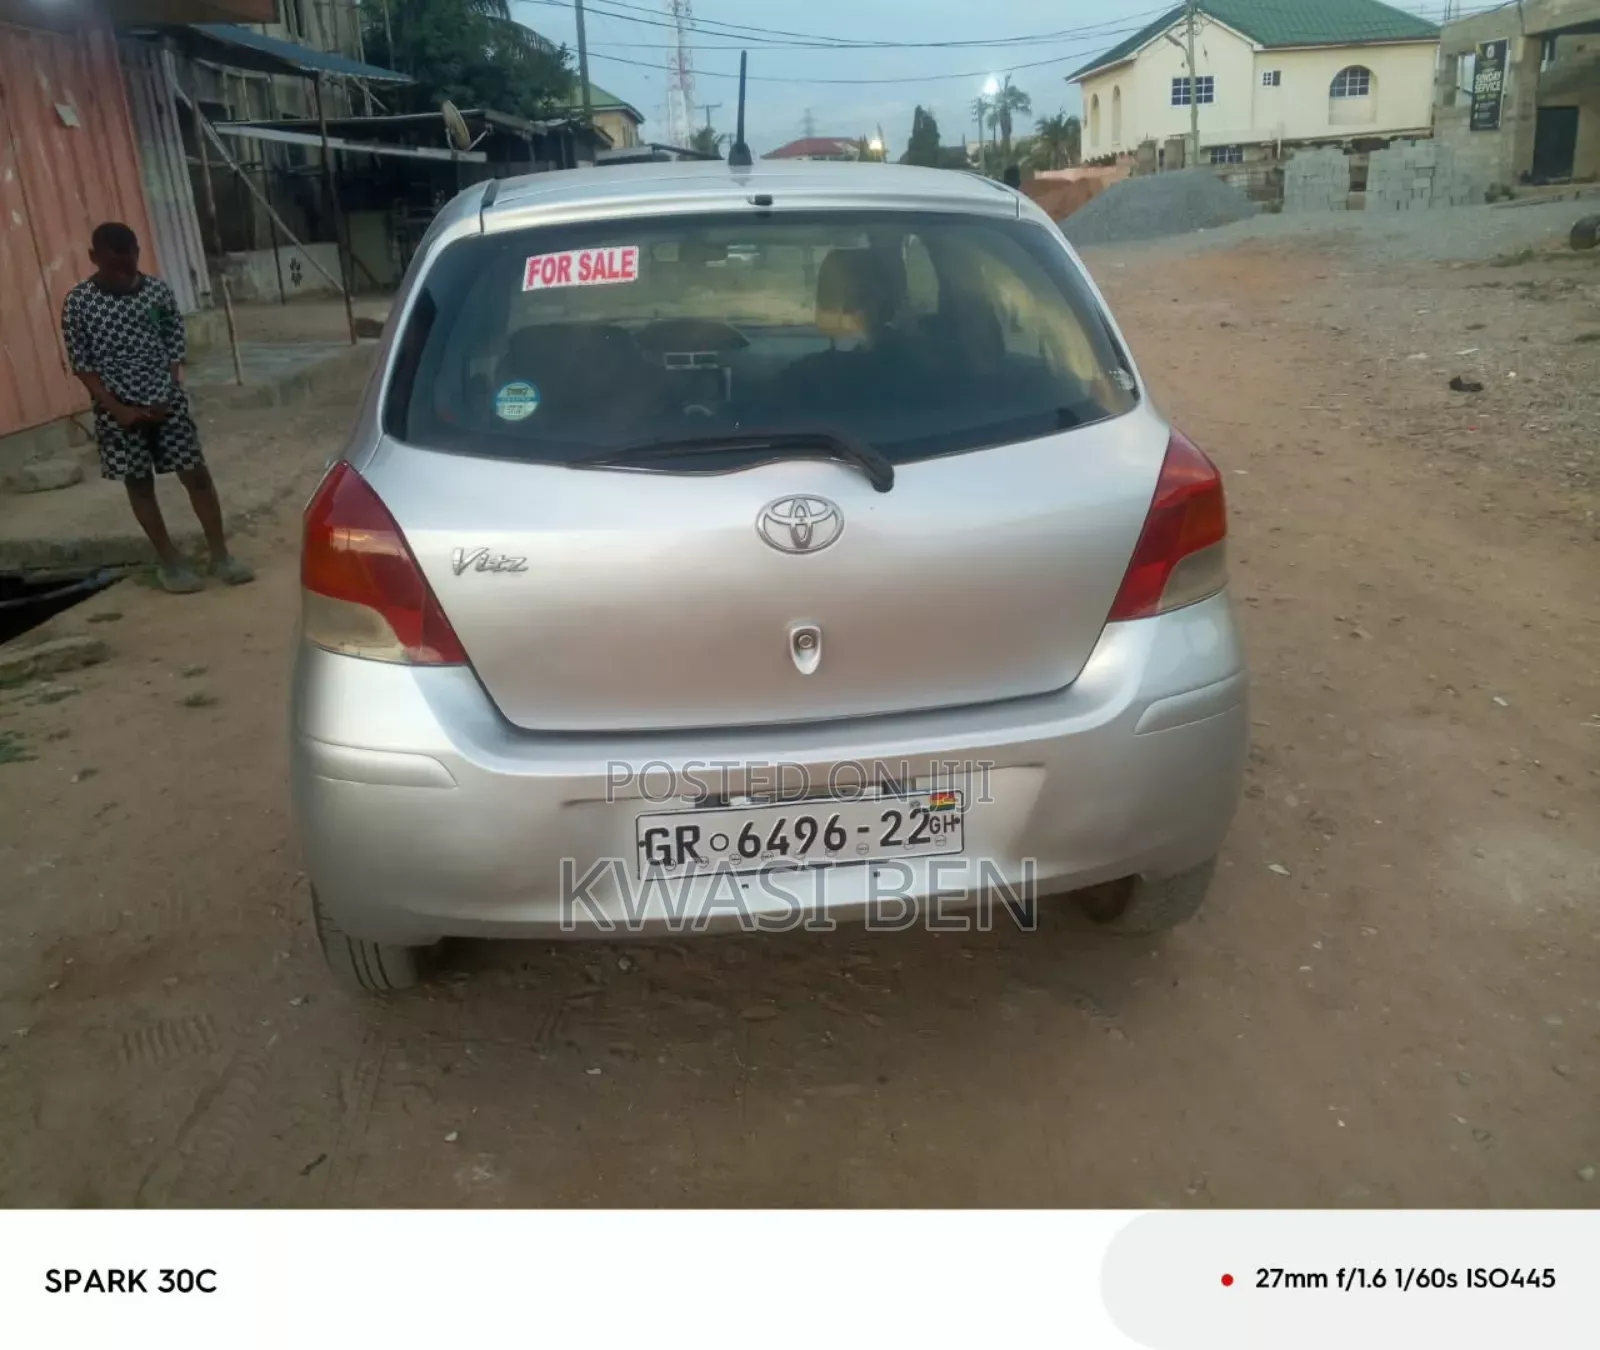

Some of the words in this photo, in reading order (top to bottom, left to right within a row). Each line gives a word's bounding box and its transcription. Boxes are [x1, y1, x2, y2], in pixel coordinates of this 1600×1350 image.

[527, 255, 572, 286] FOR
[578, 249, 635, 281] SALE
[645, 825, 703, 866] GR
[929, 814, 956, 834] GH
